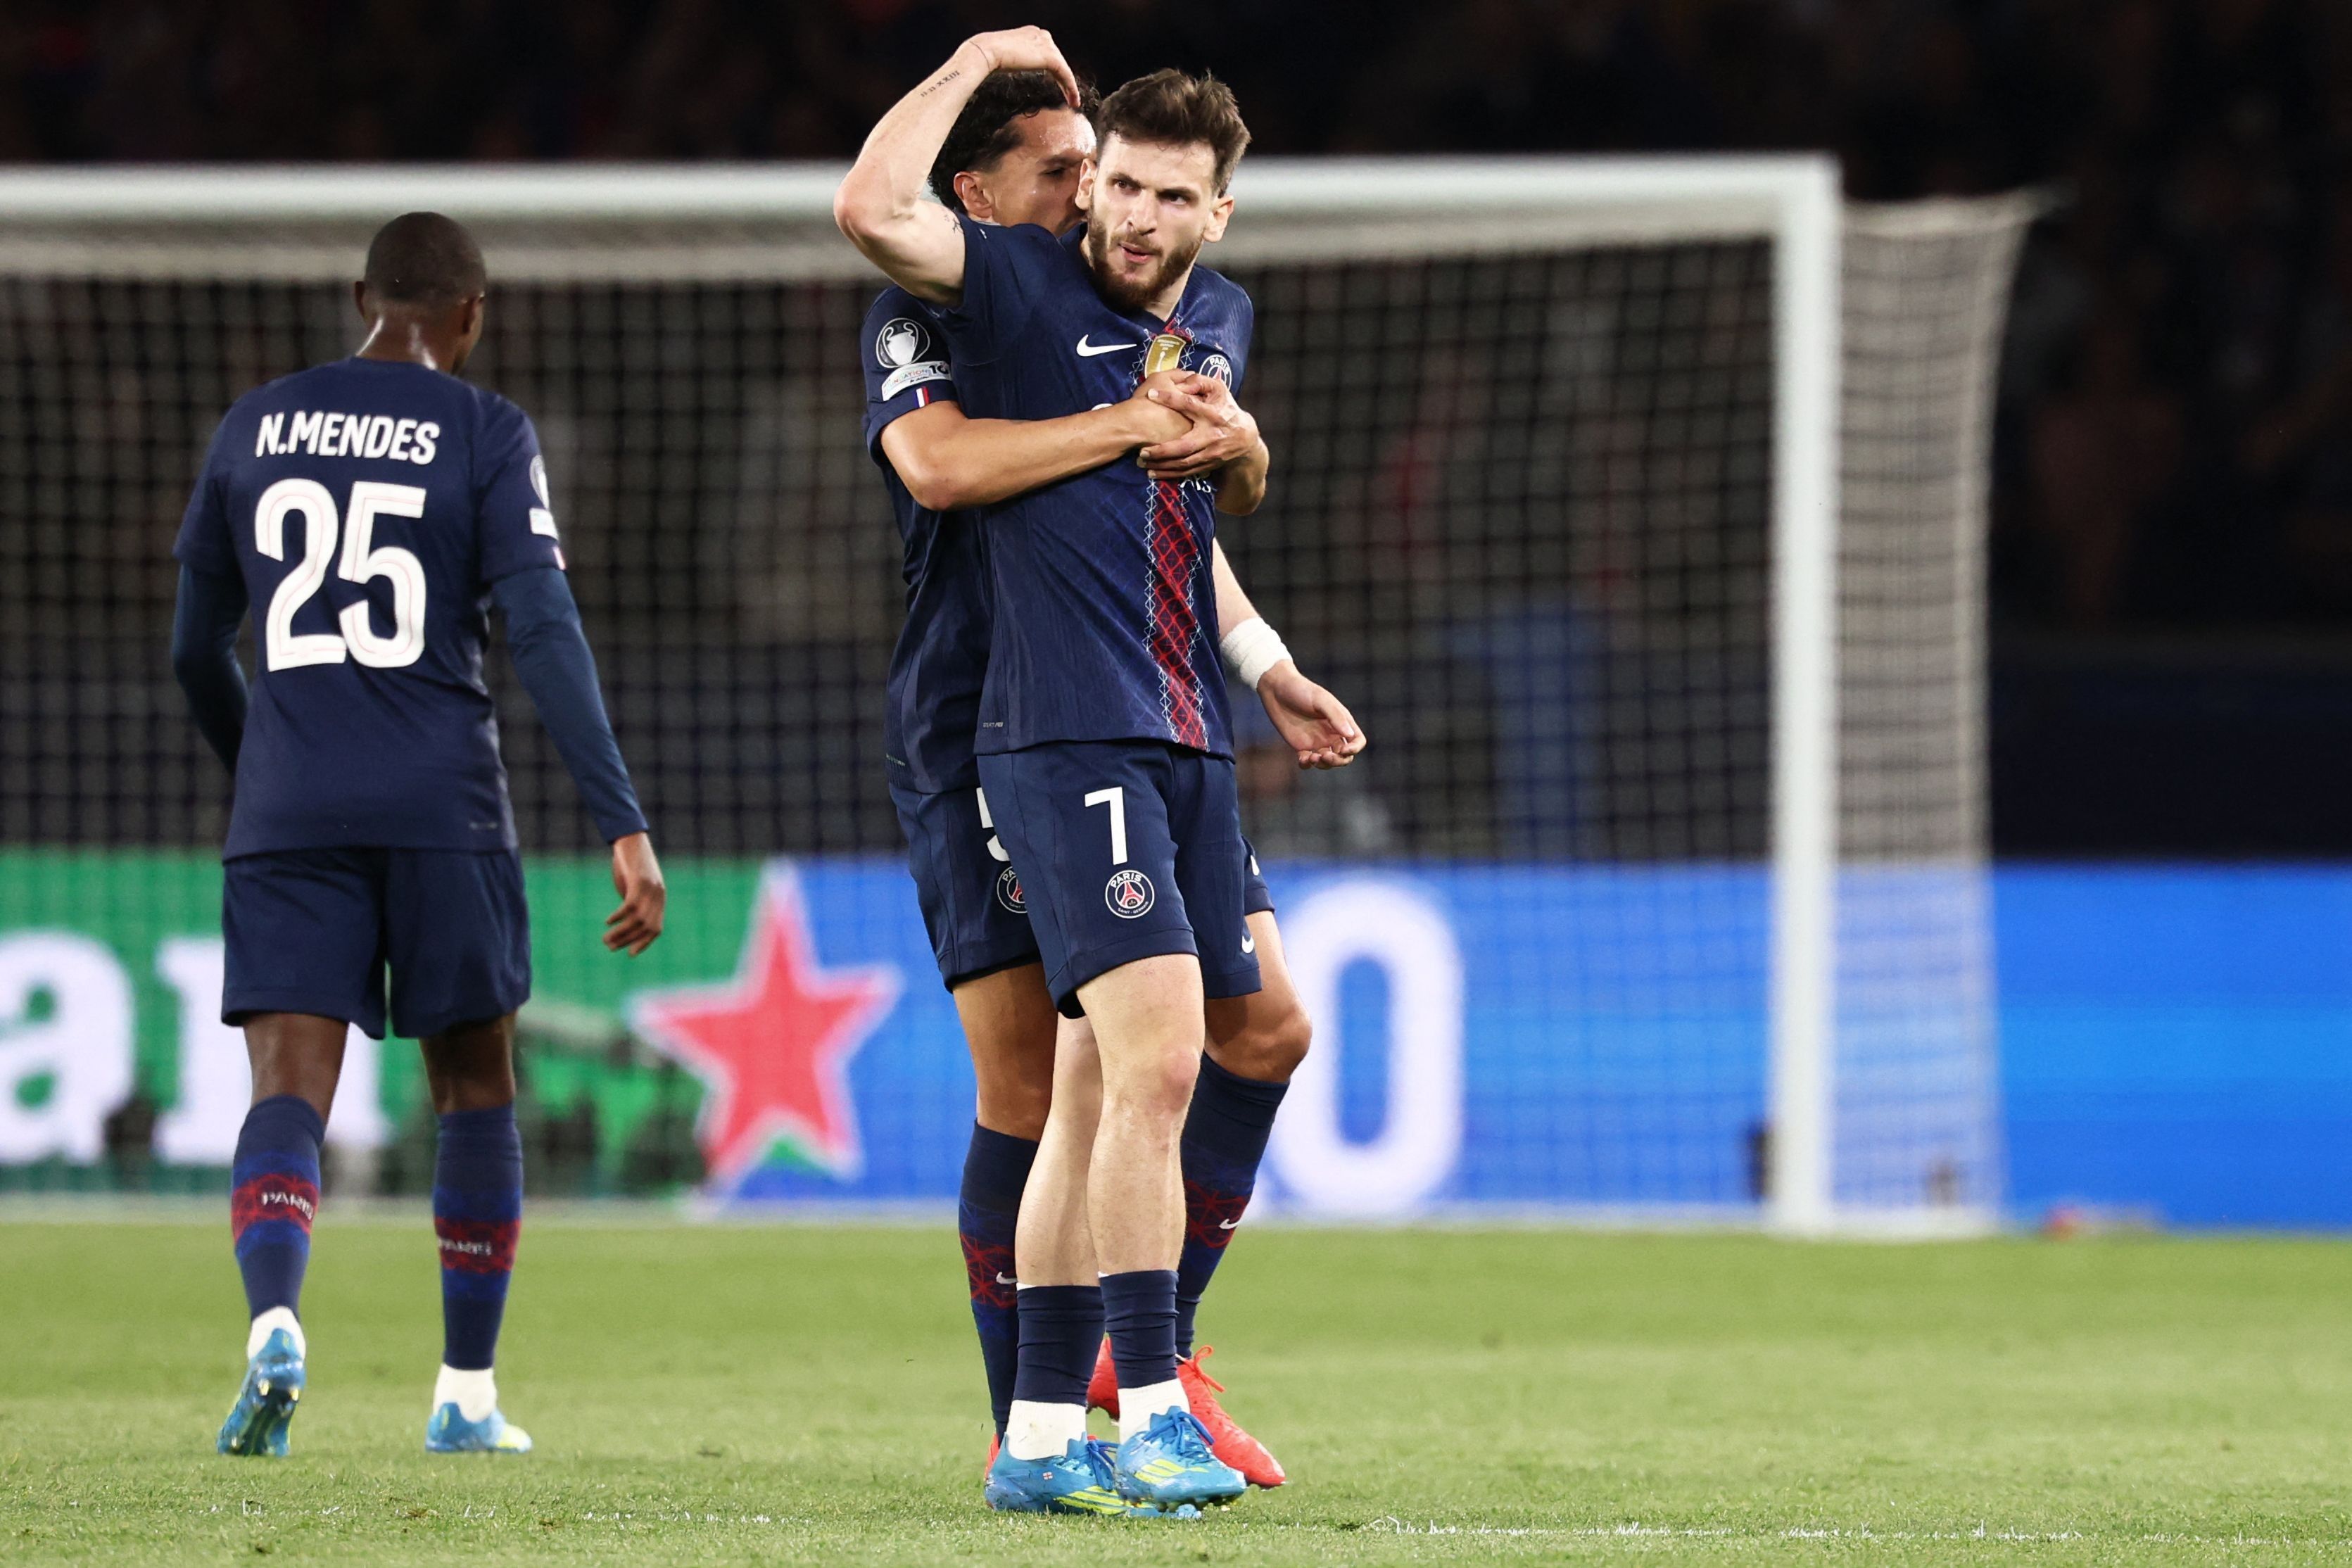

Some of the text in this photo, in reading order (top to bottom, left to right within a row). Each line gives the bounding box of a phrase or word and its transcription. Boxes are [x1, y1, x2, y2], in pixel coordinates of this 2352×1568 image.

[1210, 357, 1231, 375] PARIS
[255, 410, 441, 465] N.MENDES
[254, 478, 426, 672] 25
[1085, 786, 1128, 866] 7
[1110, 872, 1142, 887] PARIS
